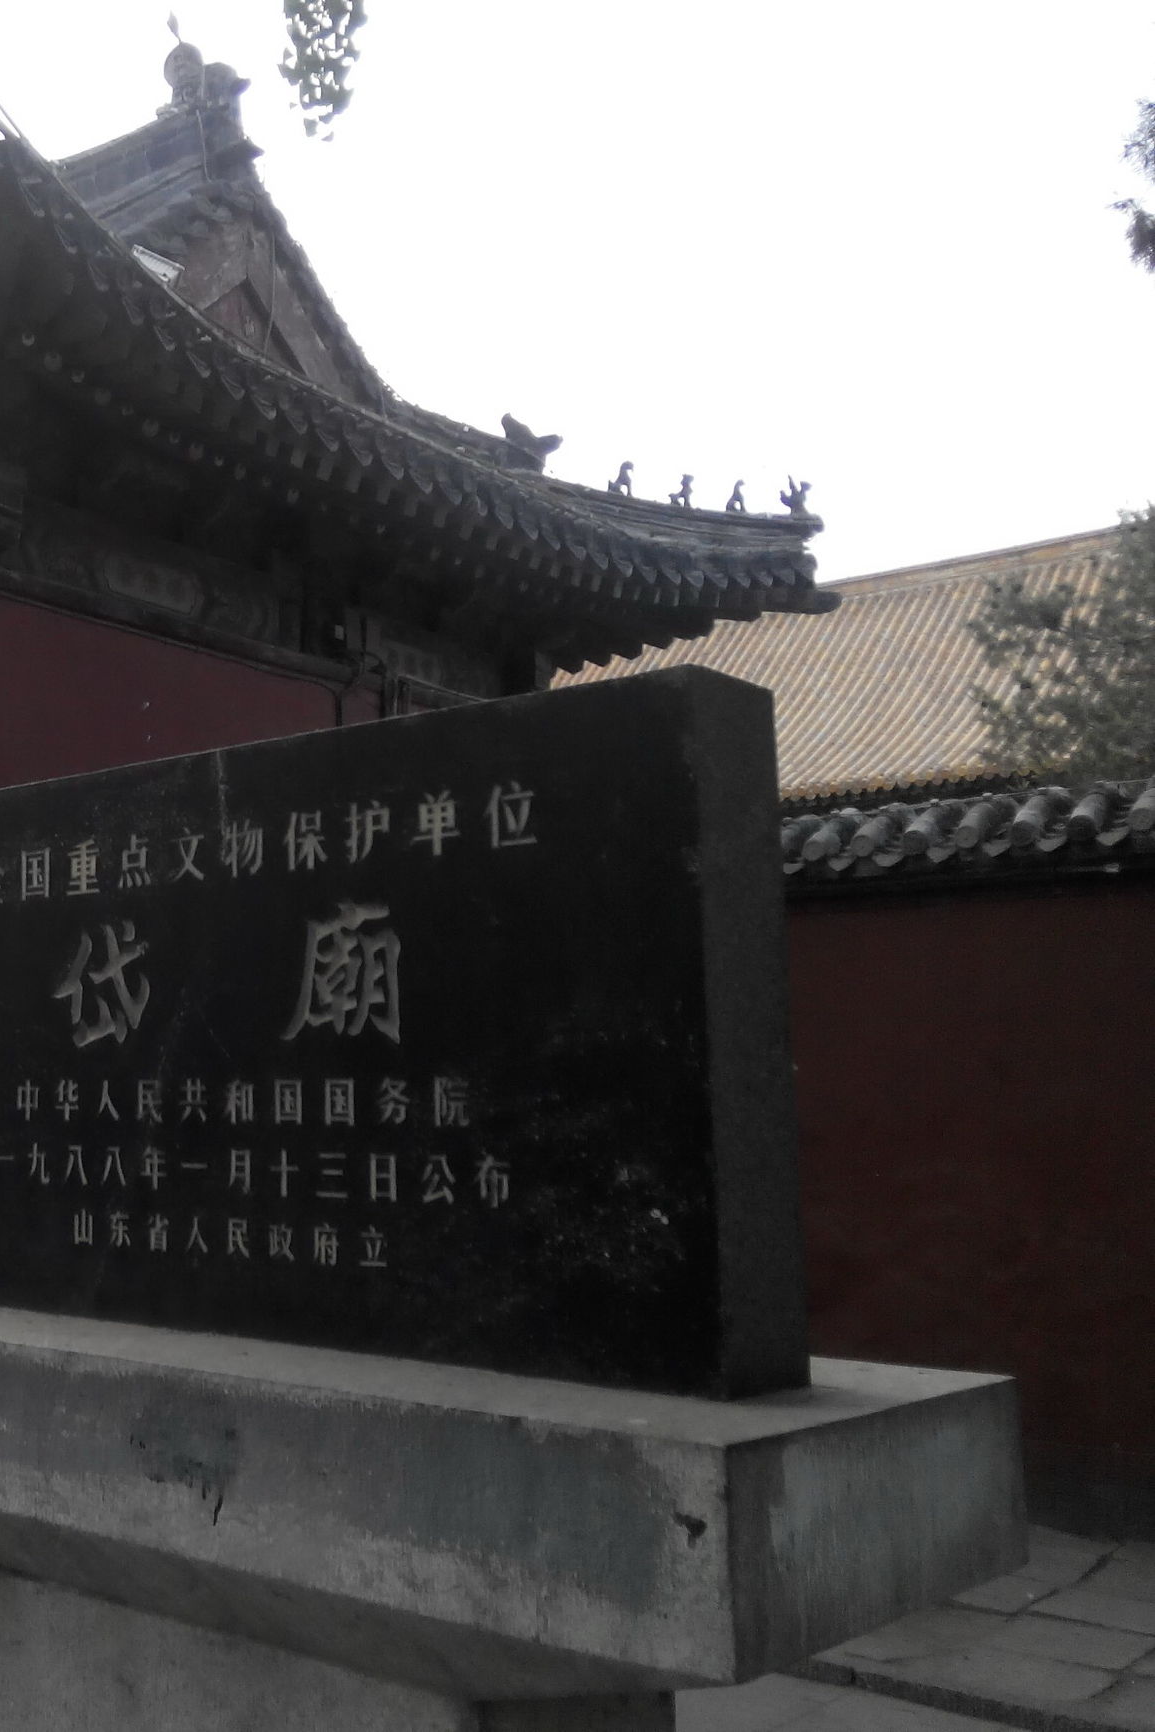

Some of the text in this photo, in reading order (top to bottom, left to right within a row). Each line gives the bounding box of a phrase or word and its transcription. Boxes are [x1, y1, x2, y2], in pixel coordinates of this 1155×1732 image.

[16, 1076, 470, 1127] 中华人民共和国国务院
[73, 1211, 388, 1268] 山东省人民政府立
